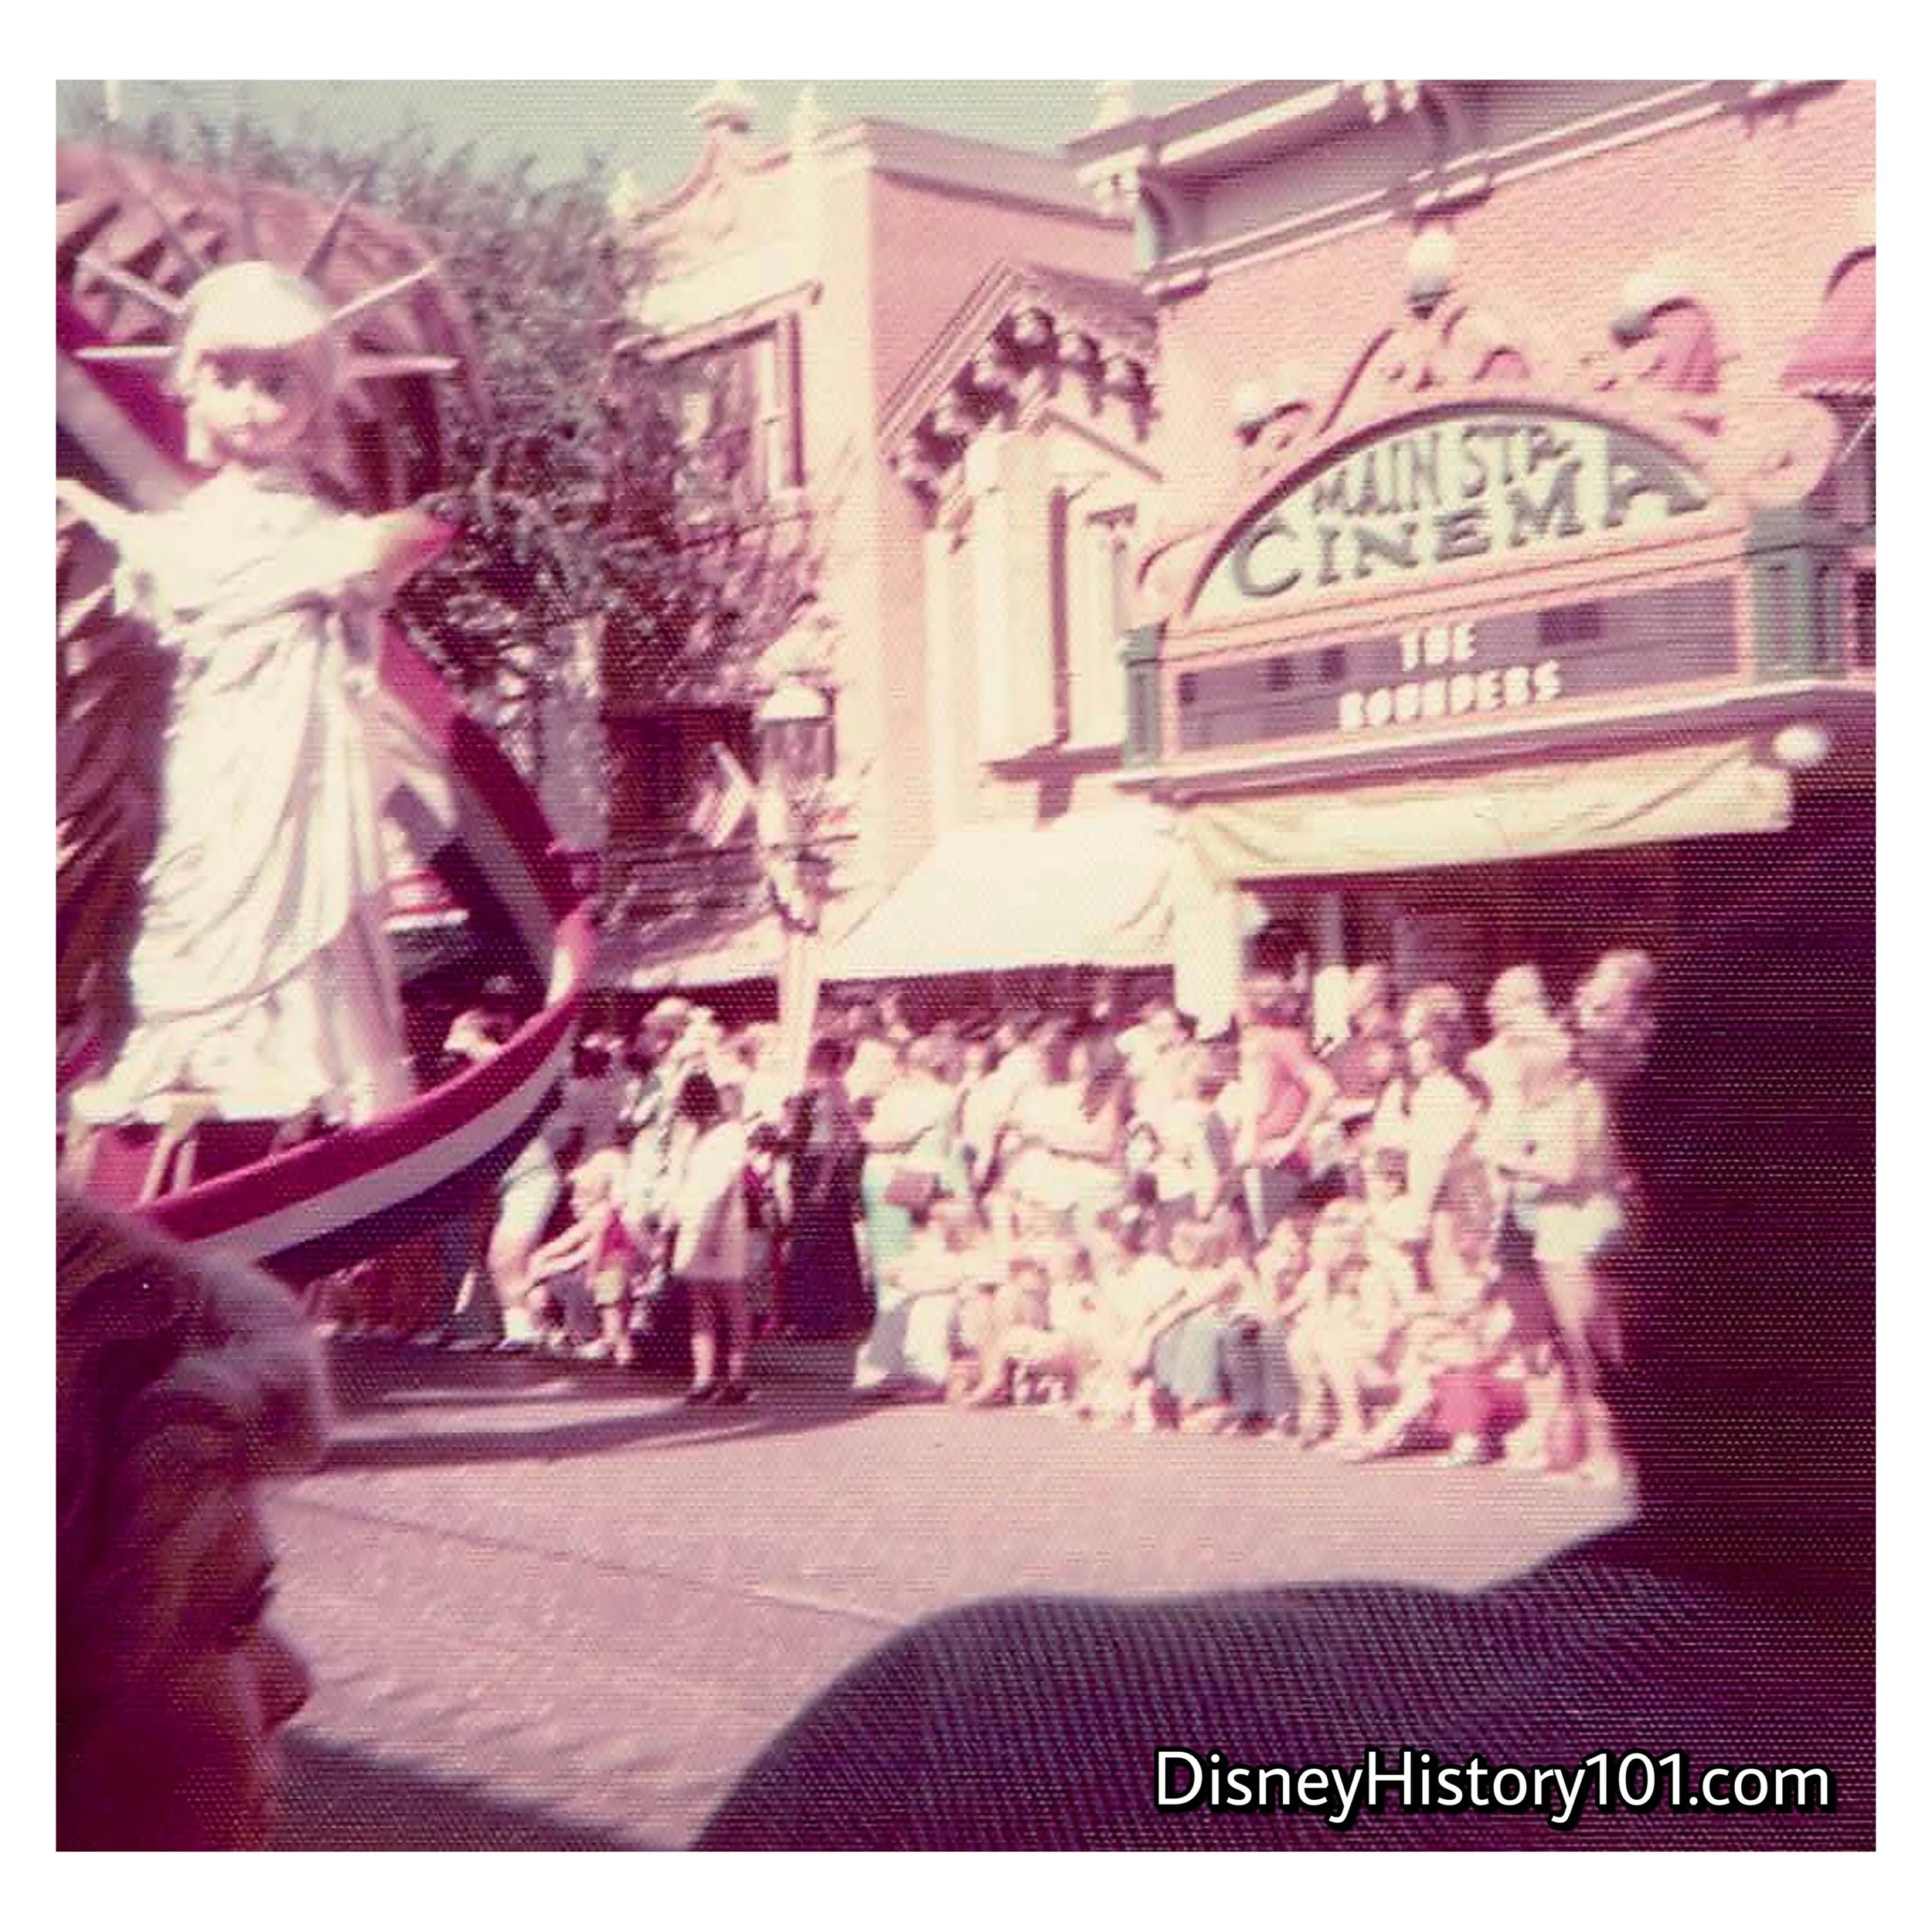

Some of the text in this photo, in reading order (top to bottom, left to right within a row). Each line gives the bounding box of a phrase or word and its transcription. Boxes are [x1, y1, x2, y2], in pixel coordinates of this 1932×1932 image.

[1312, 430, 1442, 517] MAIN
[1234, 452, 1708, 597] CINEMA
[1400, 621, 1477, 672] THE
[1338, 658, 1562, 730] ROUNDERS
